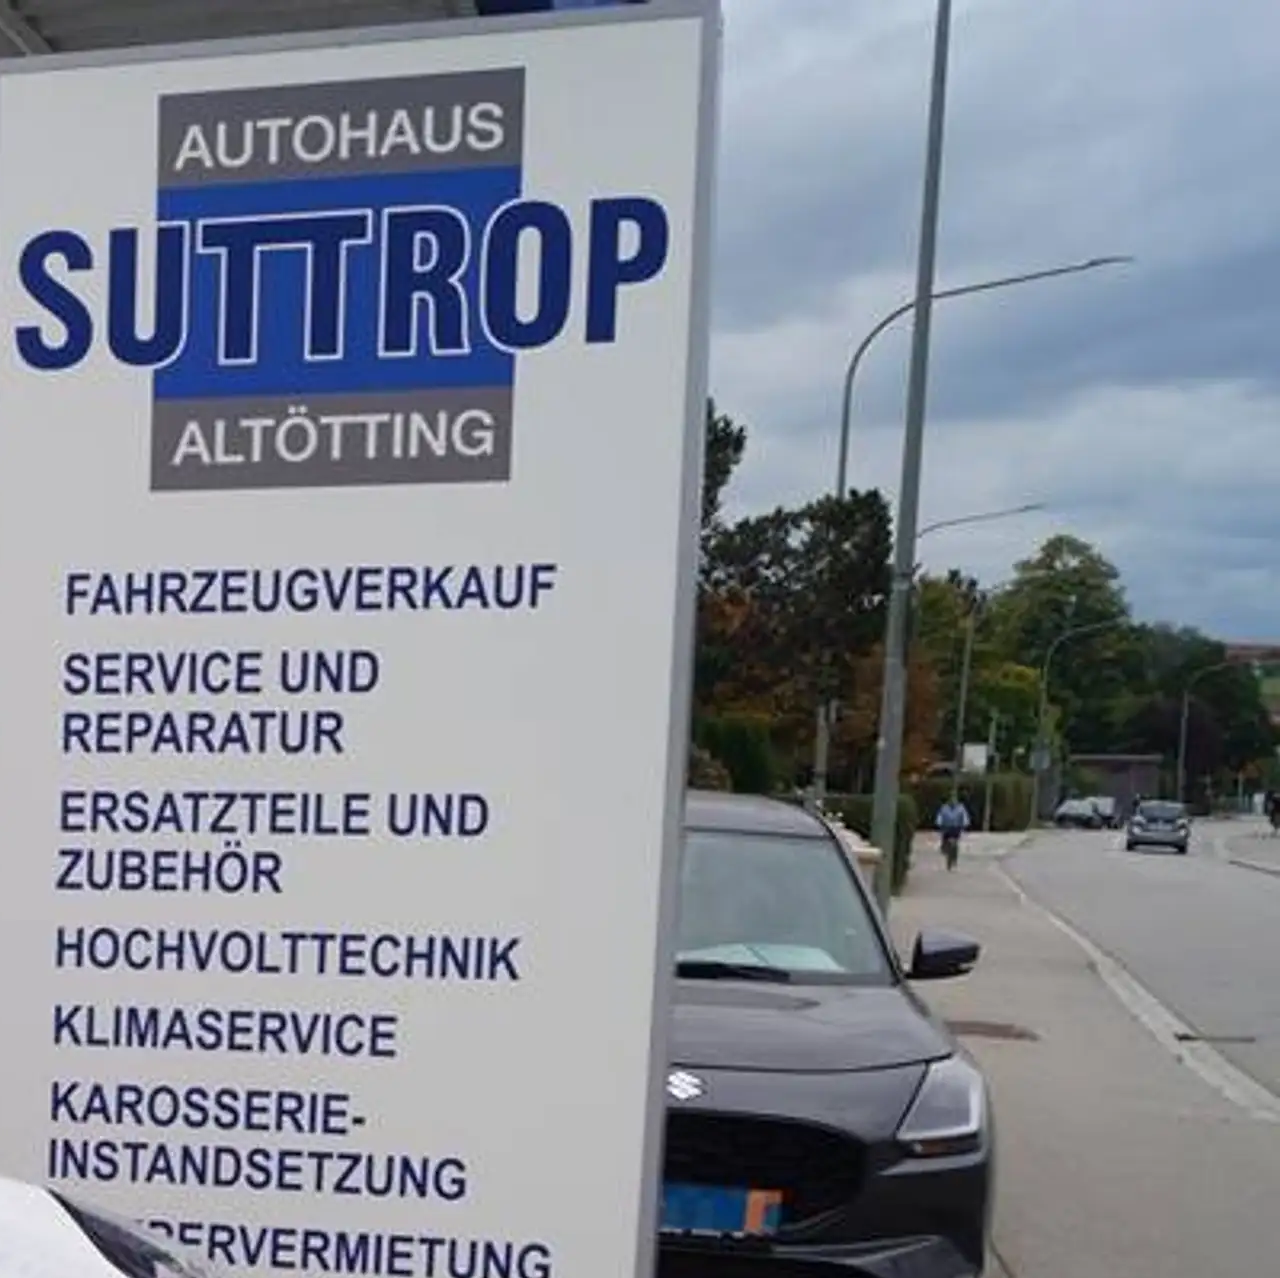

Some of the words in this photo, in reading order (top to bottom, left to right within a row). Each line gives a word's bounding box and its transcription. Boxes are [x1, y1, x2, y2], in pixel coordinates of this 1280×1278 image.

[174, 102, 505, 171] AUTOHAUS
[15, 197, 670, 370] SUTTROP
[171, 405, 495, 466] ALTÖTTING
[66, 563, 558, 616] FAHRZEUGVERKAUF
[63, 651, 263, 696] SERVICE
[280, 649, 379, 694] UND
[63, 710, 344, 754] REPARATUR
[60, 790, 371, 836] ERSATZTEILE
[388, 793, 489, 837] UND
[55, 840, 283, 894] ZUBEHÖR
[56, 927, 520, 981] HOCHVOLTTECHNIK
[53, 1004, 398, 1058] KLIMASERVICE
[50, 1081, 366, 1136] KAROSSERIE-
[48, 1138, 466, 1201] INSTANDSETZUNG
